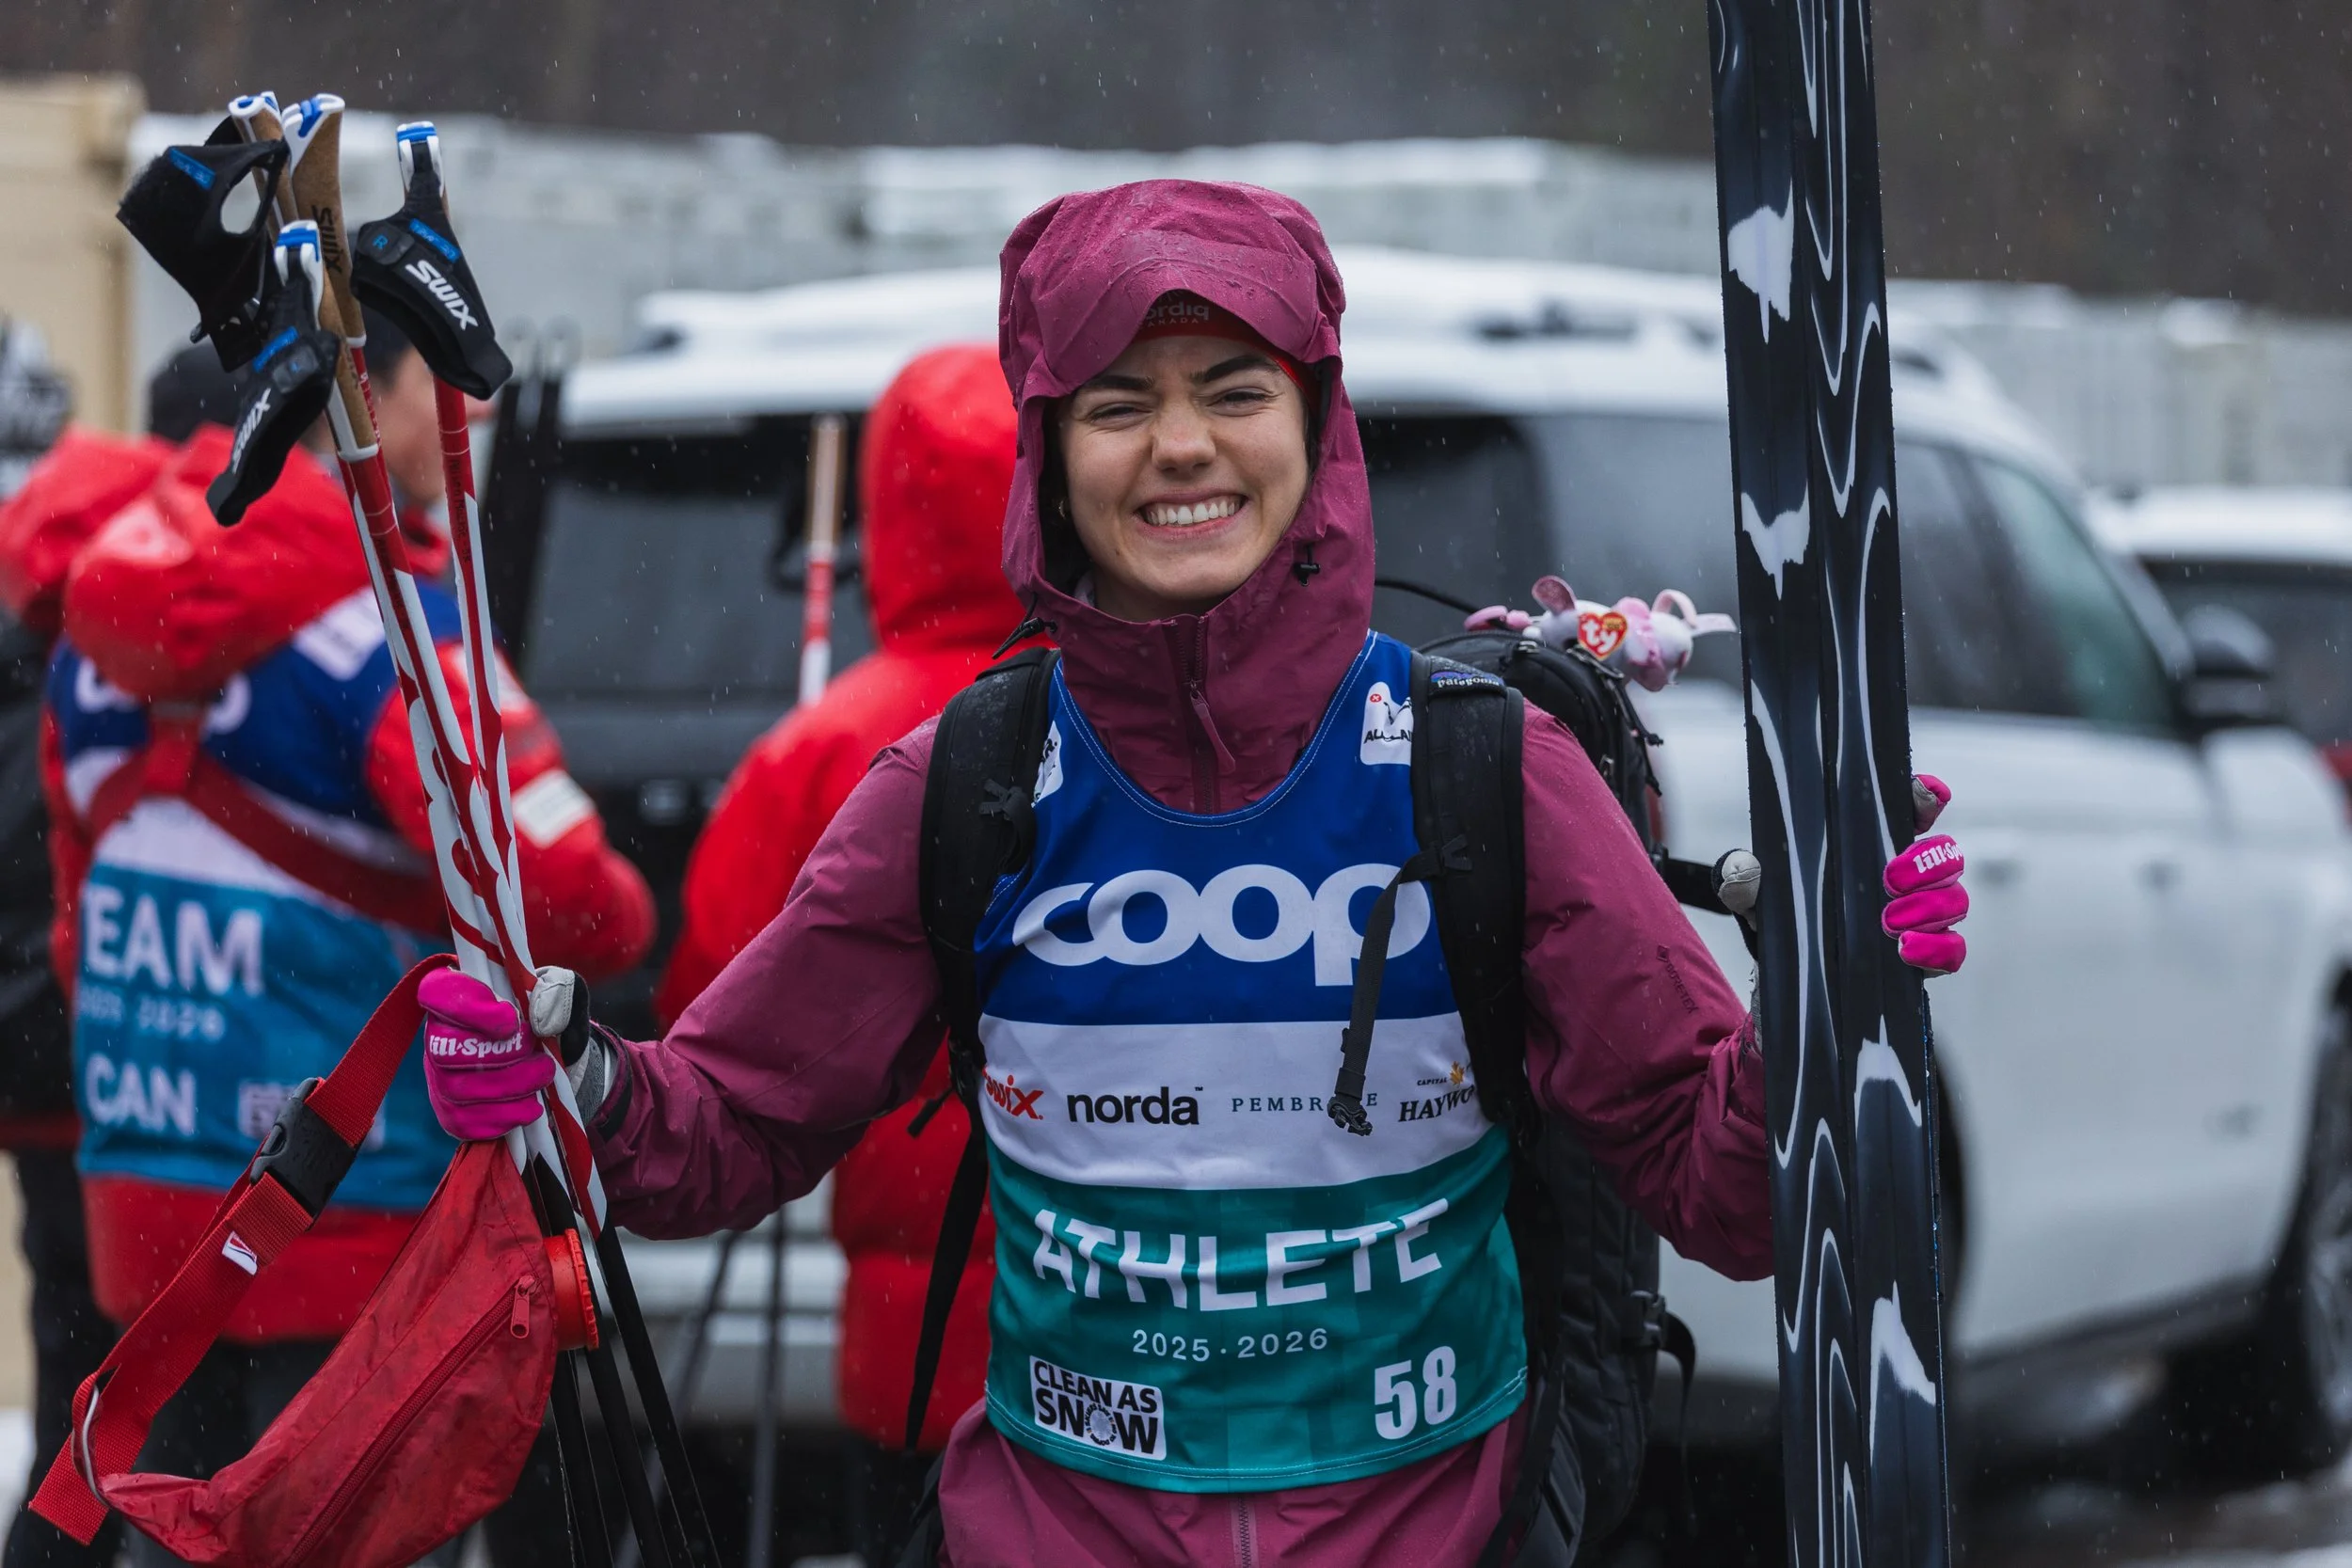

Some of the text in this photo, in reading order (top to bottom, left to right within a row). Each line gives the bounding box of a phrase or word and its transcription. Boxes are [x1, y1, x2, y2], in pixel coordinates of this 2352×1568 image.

[1147, 301, 1209, 322] ordiq
[1148, 317, 1200, 327] ANADA
[1581, 620, 1617, 653] ty
[83, 882, 262, 997] EAM
[1012, 863, 1431, 986] coop
[86, 1052, 197, 1135] CAN
[1232, 1092, 1377, 1113] PEMBRE
[1398, 1084, 1475, 1122] HAYWO
[1033, 1198, 1450, 1312] ATHLETE
[1034, 1360, 1157, 1414] CLEAN AS
[1374, 1346, 1457, 1440] 58
